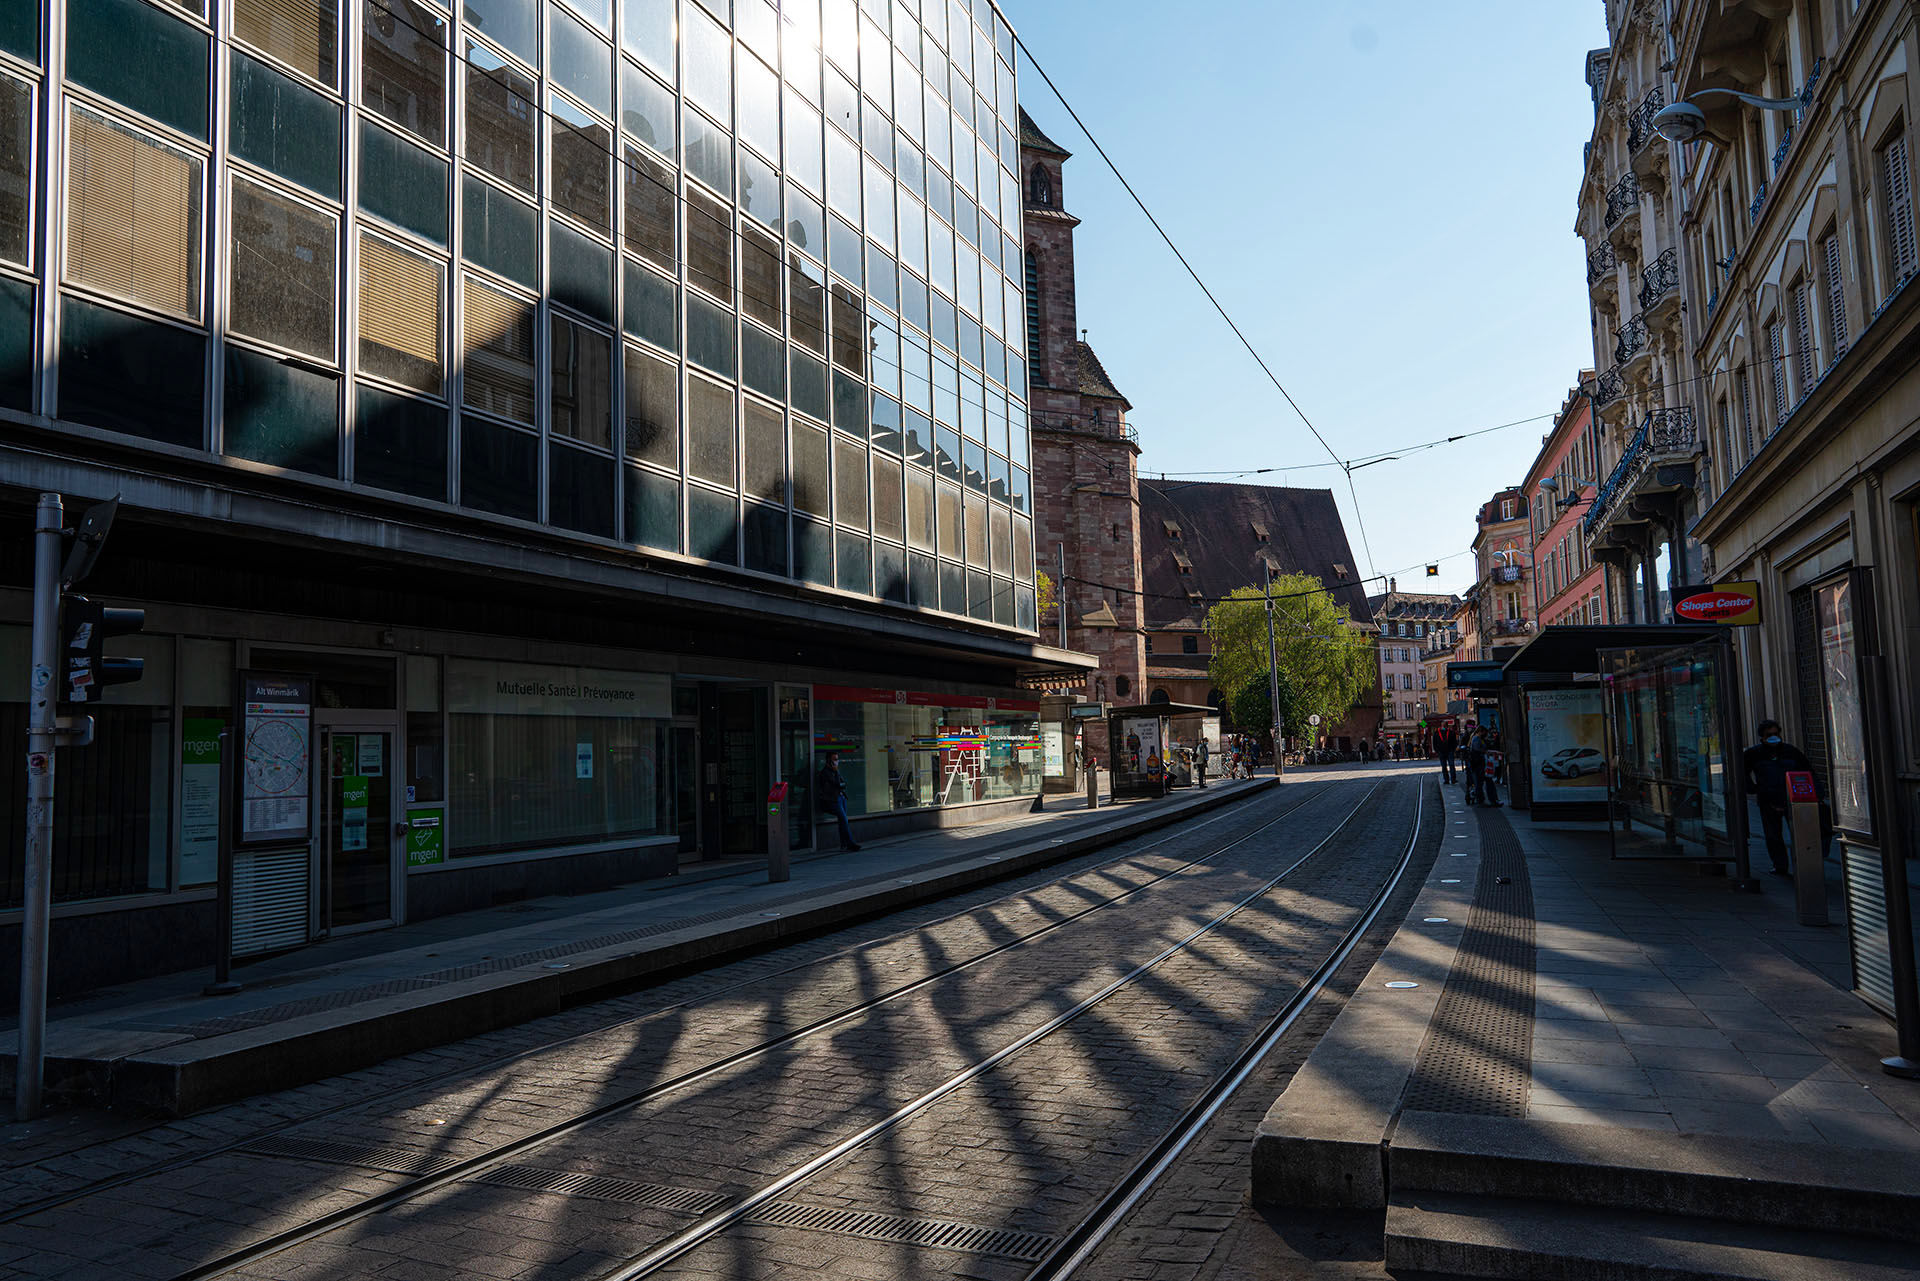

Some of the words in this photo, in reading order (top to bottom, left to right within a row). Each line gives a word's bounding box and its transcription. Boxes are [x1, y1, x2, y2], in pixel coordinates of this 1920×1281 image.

[1681, 601, 1714, 612] Shops
[1716, 597, 1753, 608] Center
[1702, 609, 1731, 618] Sports
[256, 687, 266, 696] Alt
[266, 687, 300, 697] Winmärik
[496, 681, 545, 696] Mutuelle
[548, 683, 577, 697] Santé
[583, 686, 635, 702] Prévoyance
[183, 740, 220, 755] mgen
[343, 789, 365, 801] mgen
[410, 848, 438, 864] mgen
